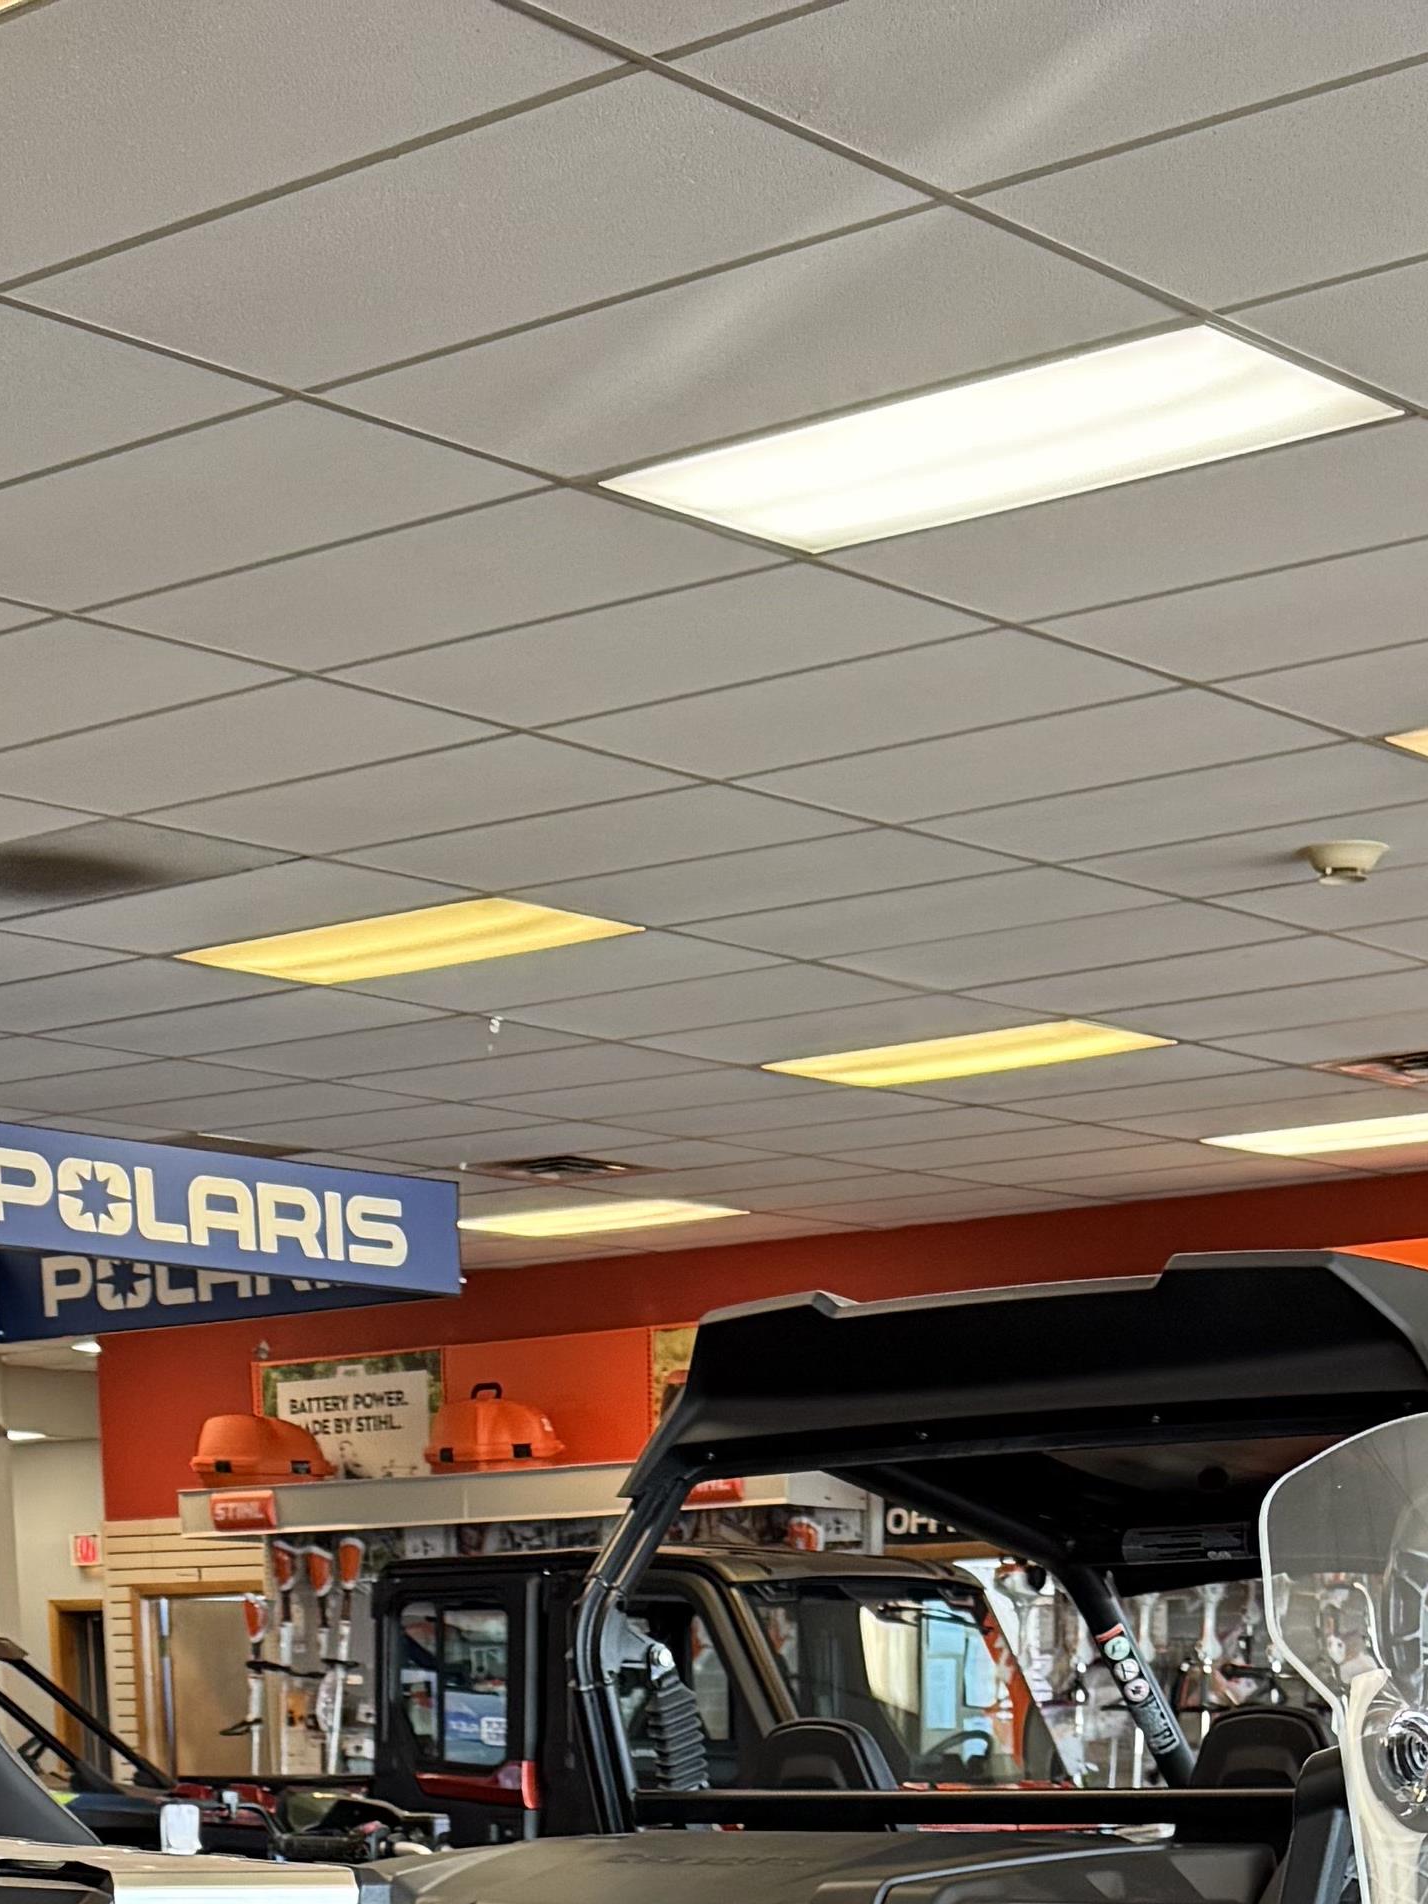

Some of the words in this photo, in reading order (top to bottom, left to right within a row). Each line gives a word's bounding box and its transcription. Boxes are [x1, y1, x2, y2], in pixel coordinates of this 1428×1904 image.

[41, 1256, 348, 1318] POLA
[289, 1396, 348, 1415] BATTERY
[353, 1390, 409, 1410] POWER.
[306, 1418, 330, 1436] ADE
[334, 1417, 353, 1435] BY
[214, 1503, 265, 1521] STIHL
